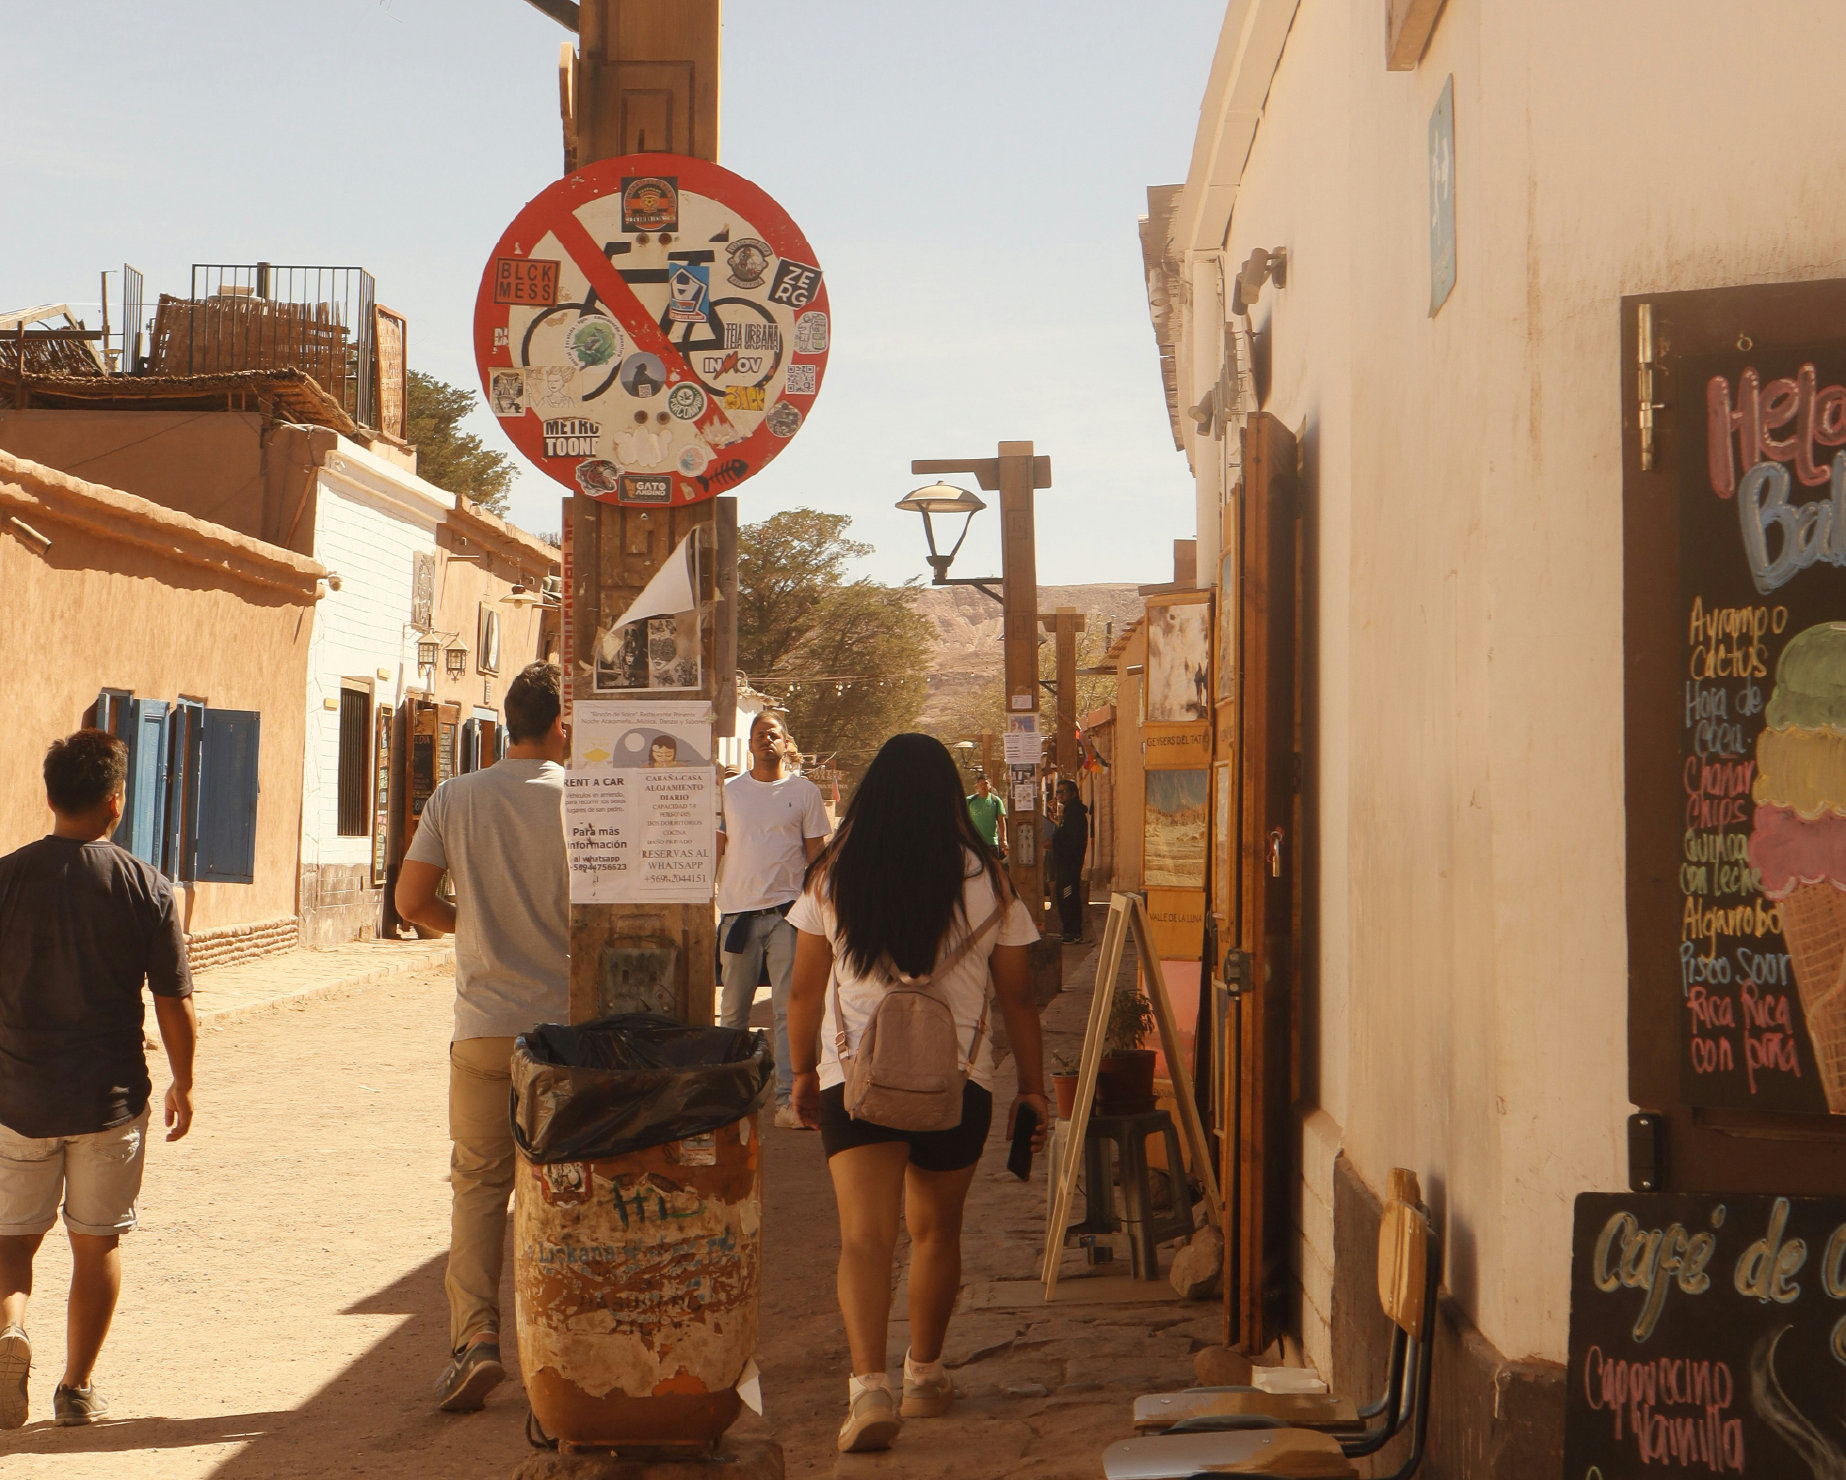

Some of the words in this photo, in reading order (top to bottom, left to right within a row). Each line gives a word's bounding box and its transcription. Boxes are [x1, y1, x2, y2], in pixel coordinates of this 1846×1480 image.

[501, 262, 552, 282] BLCK
[783, 266, 815, 288] ZE
[499, 281, 551, 301] MESS
[775, 283, 808, 305] RG
[744, 323, 778, 350] URBANA
[636, 481, 667, 491] GATO
[1686, 680, 1728, 728] Hoja
[1735, 676, 1765, 717] de
[1146, 735, 1176, 747] GEYSERS
[564, 778, 590, 787] RENT
[593, 778, 600, 786] A
[603, 777, 625, 786] CAR
[573, 827, 596, 836] Para
[599, 826, 620, 836] más
[567, 840, 627, 849] información
[642, 849, 694, 858] RESERVAS
[695, 849, 709, 858] AL
[582, 855, 620, 863] whatsapp
[648, 861, 704, 870] WHATSAPP
[1714, 860, 1767, 897] leche
[1149, 912, 1168, 922] VALLE
[1168, 912, 1178, 923] DE
[1178, 913, 1187, 923] LA
[1682, 896, 1785, 962] Algarrobo
[1680, 941, 1732, 997] Pisco
[1687, 986, 1736, 1034] Rica
[1741, 978, 1793, 1034] Rica
[1691, 1036, 1734, 1075] con
[1593, 1204, 1726, 1343] Café
[1734, 1197, 1808, 1304] de
